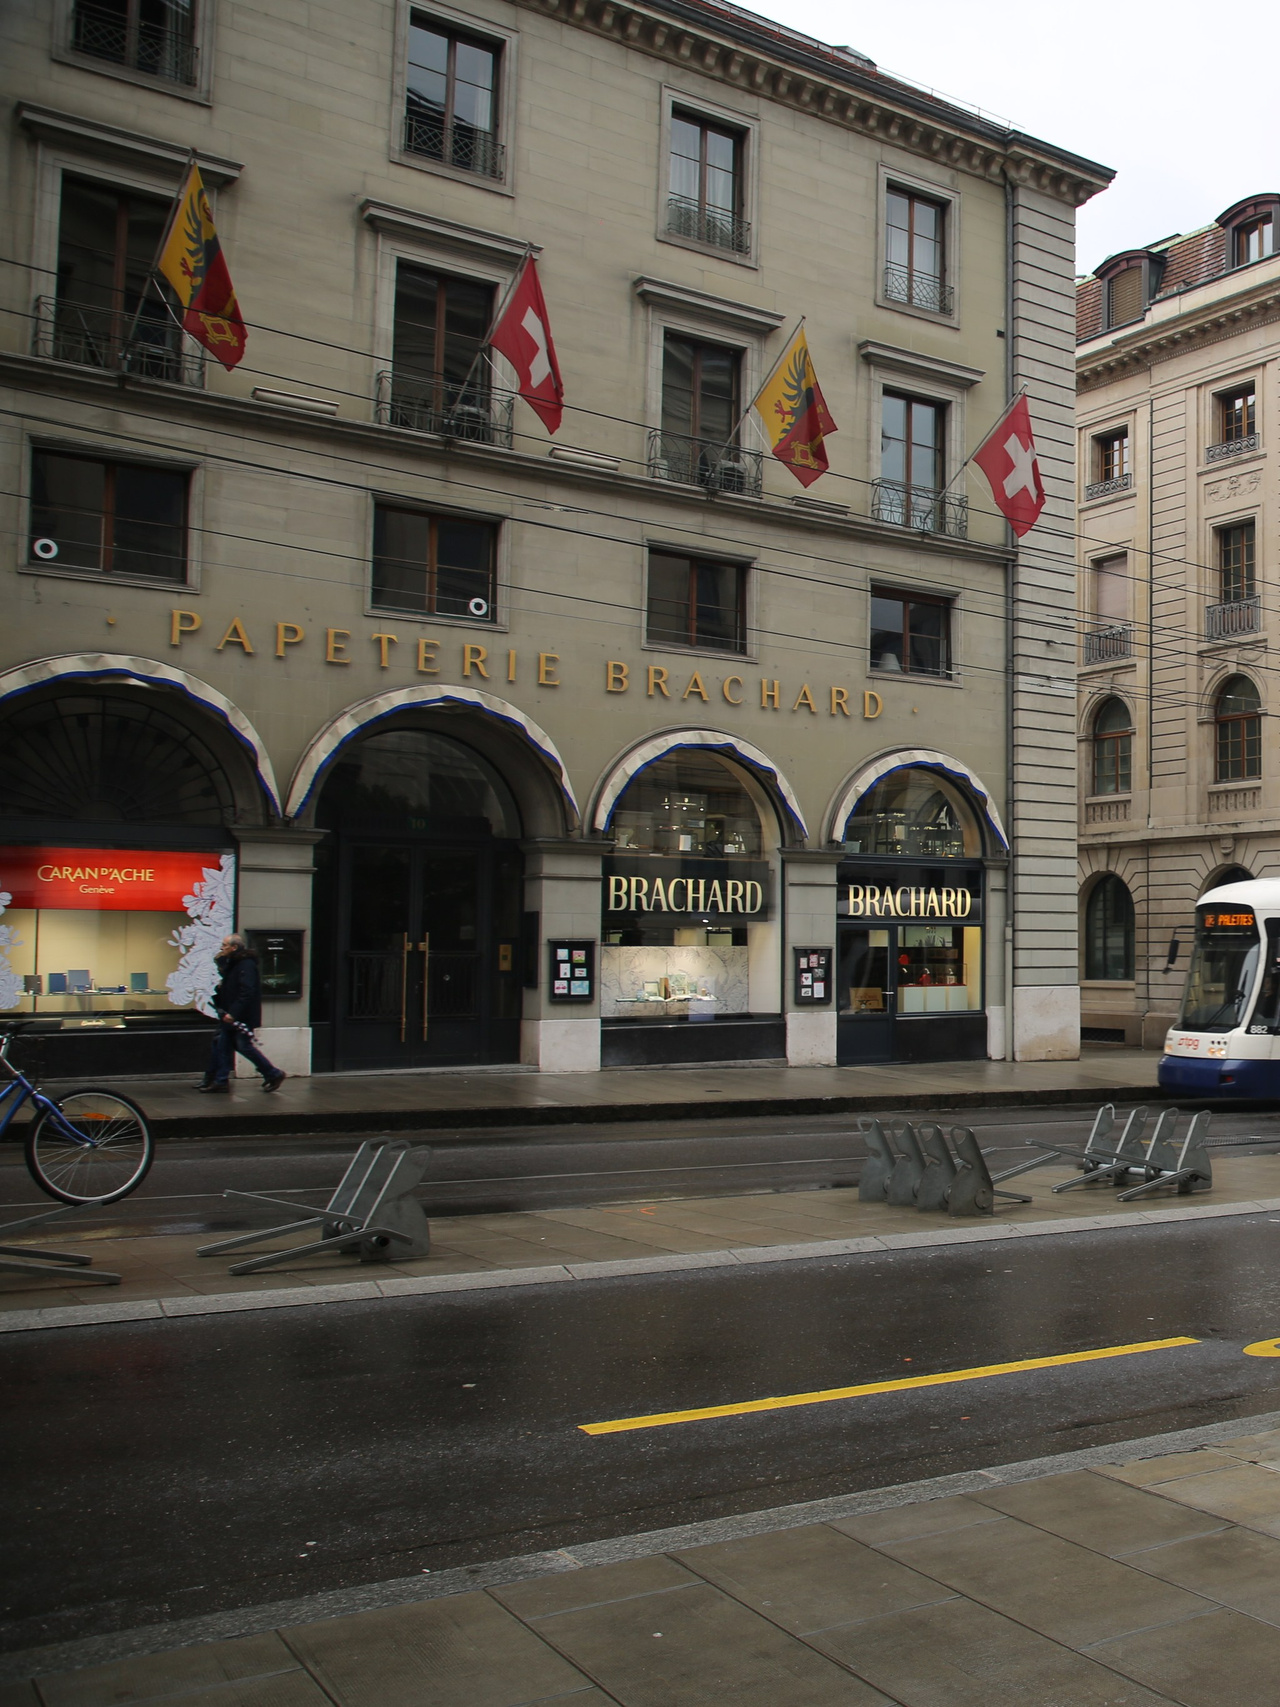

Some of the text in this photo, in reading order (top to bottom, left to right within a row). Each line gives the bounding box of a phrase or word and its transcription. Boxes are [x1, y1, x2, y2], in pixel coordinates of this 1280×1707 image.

[170, 608, 884, 719] PAPETERIE BRACHARD
[37, 865, 98, 882] CARAN
[79, 884, 115, 894] Genève
[608, 875, 763, 914] BRACHARD
[848, 884, 972, 918] BRACHARD
[1218, 914, 1254, 926] PALETTES
[1250, 1025, 1268, 1034] 882
